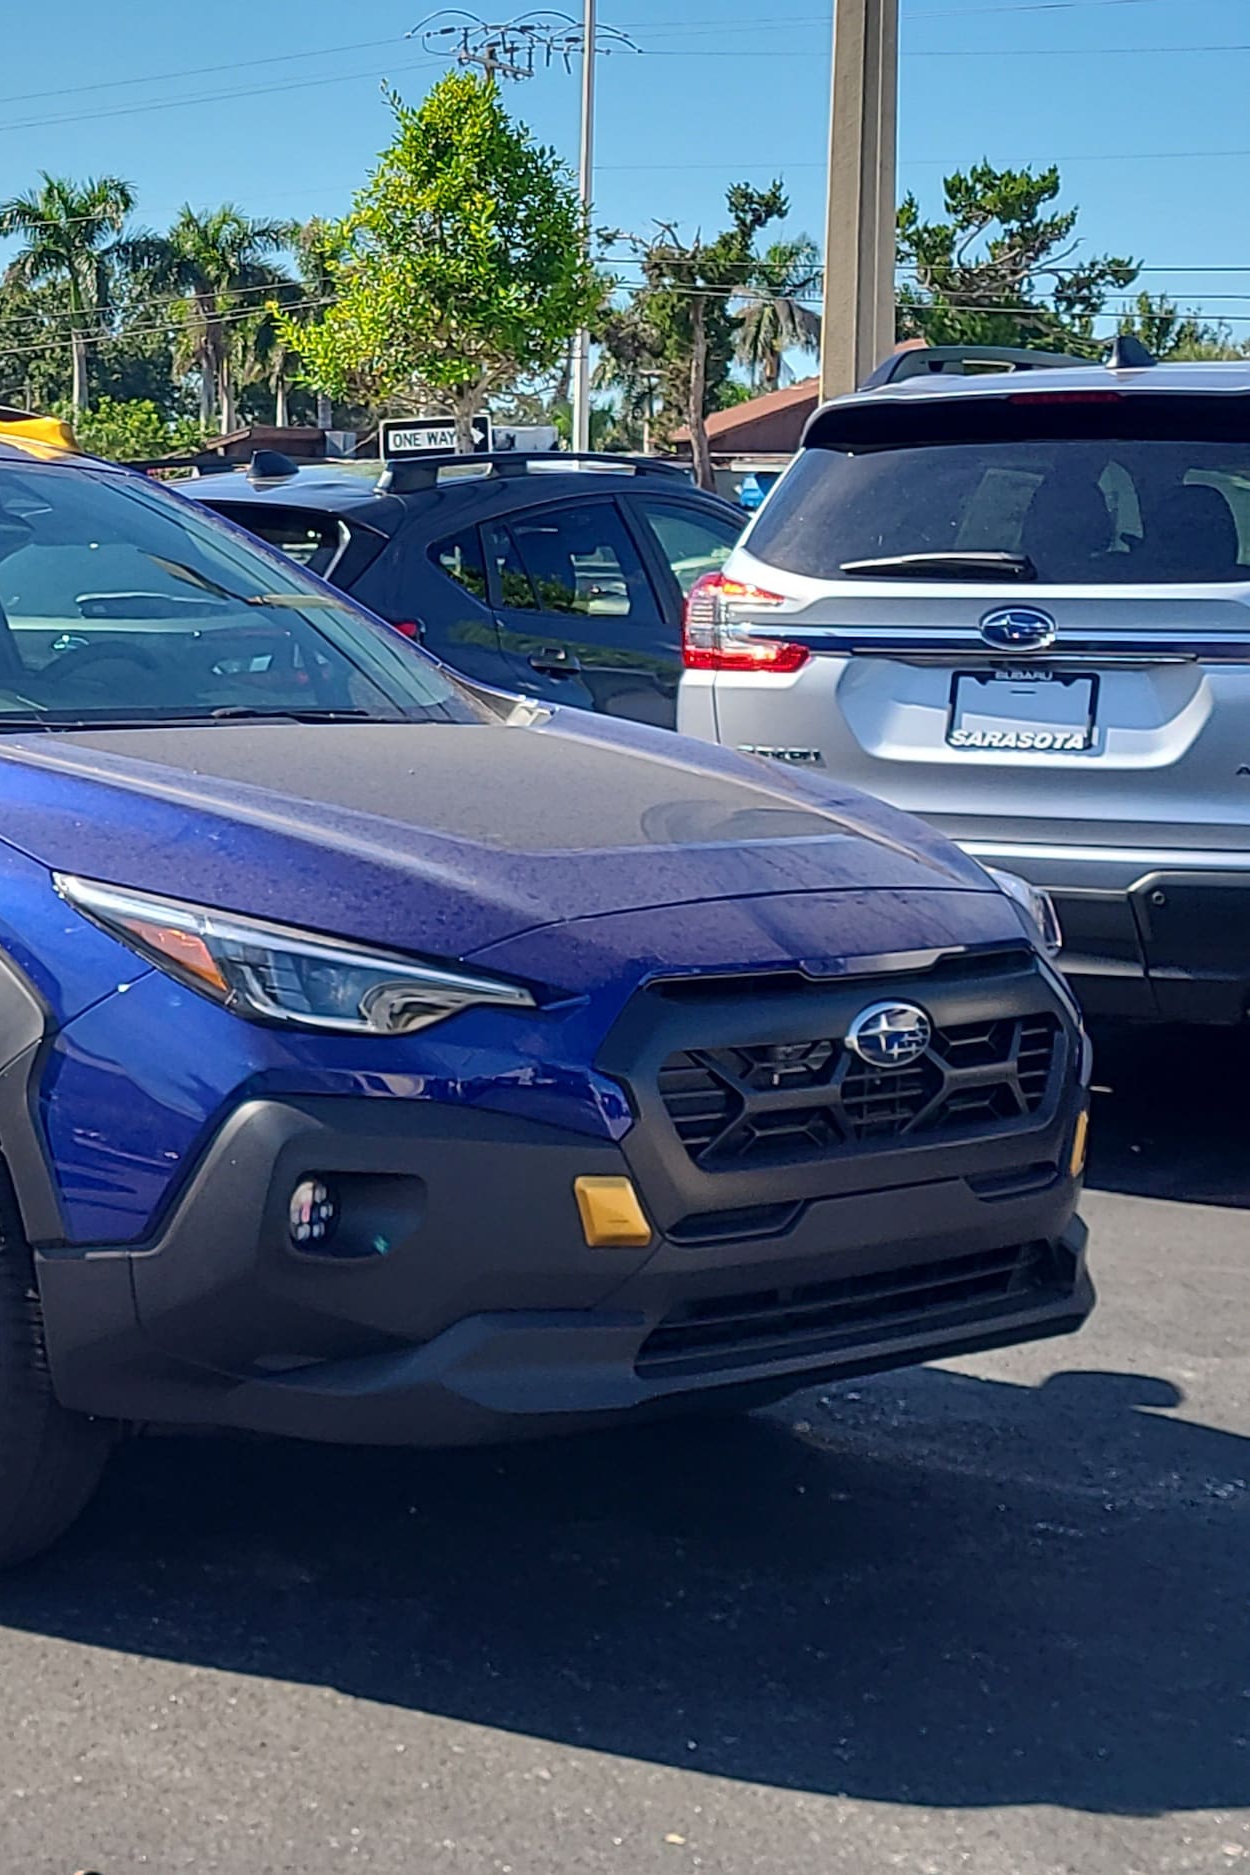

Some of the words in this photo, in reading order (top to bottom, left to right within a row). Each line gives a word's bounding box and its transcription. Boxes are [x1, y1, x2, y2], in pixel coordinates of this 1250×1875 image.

[392, 432, 421, 448] ONE
[427, 431, 457, 446] WAY
[950, 729, 1085, 750] SARASOTA
